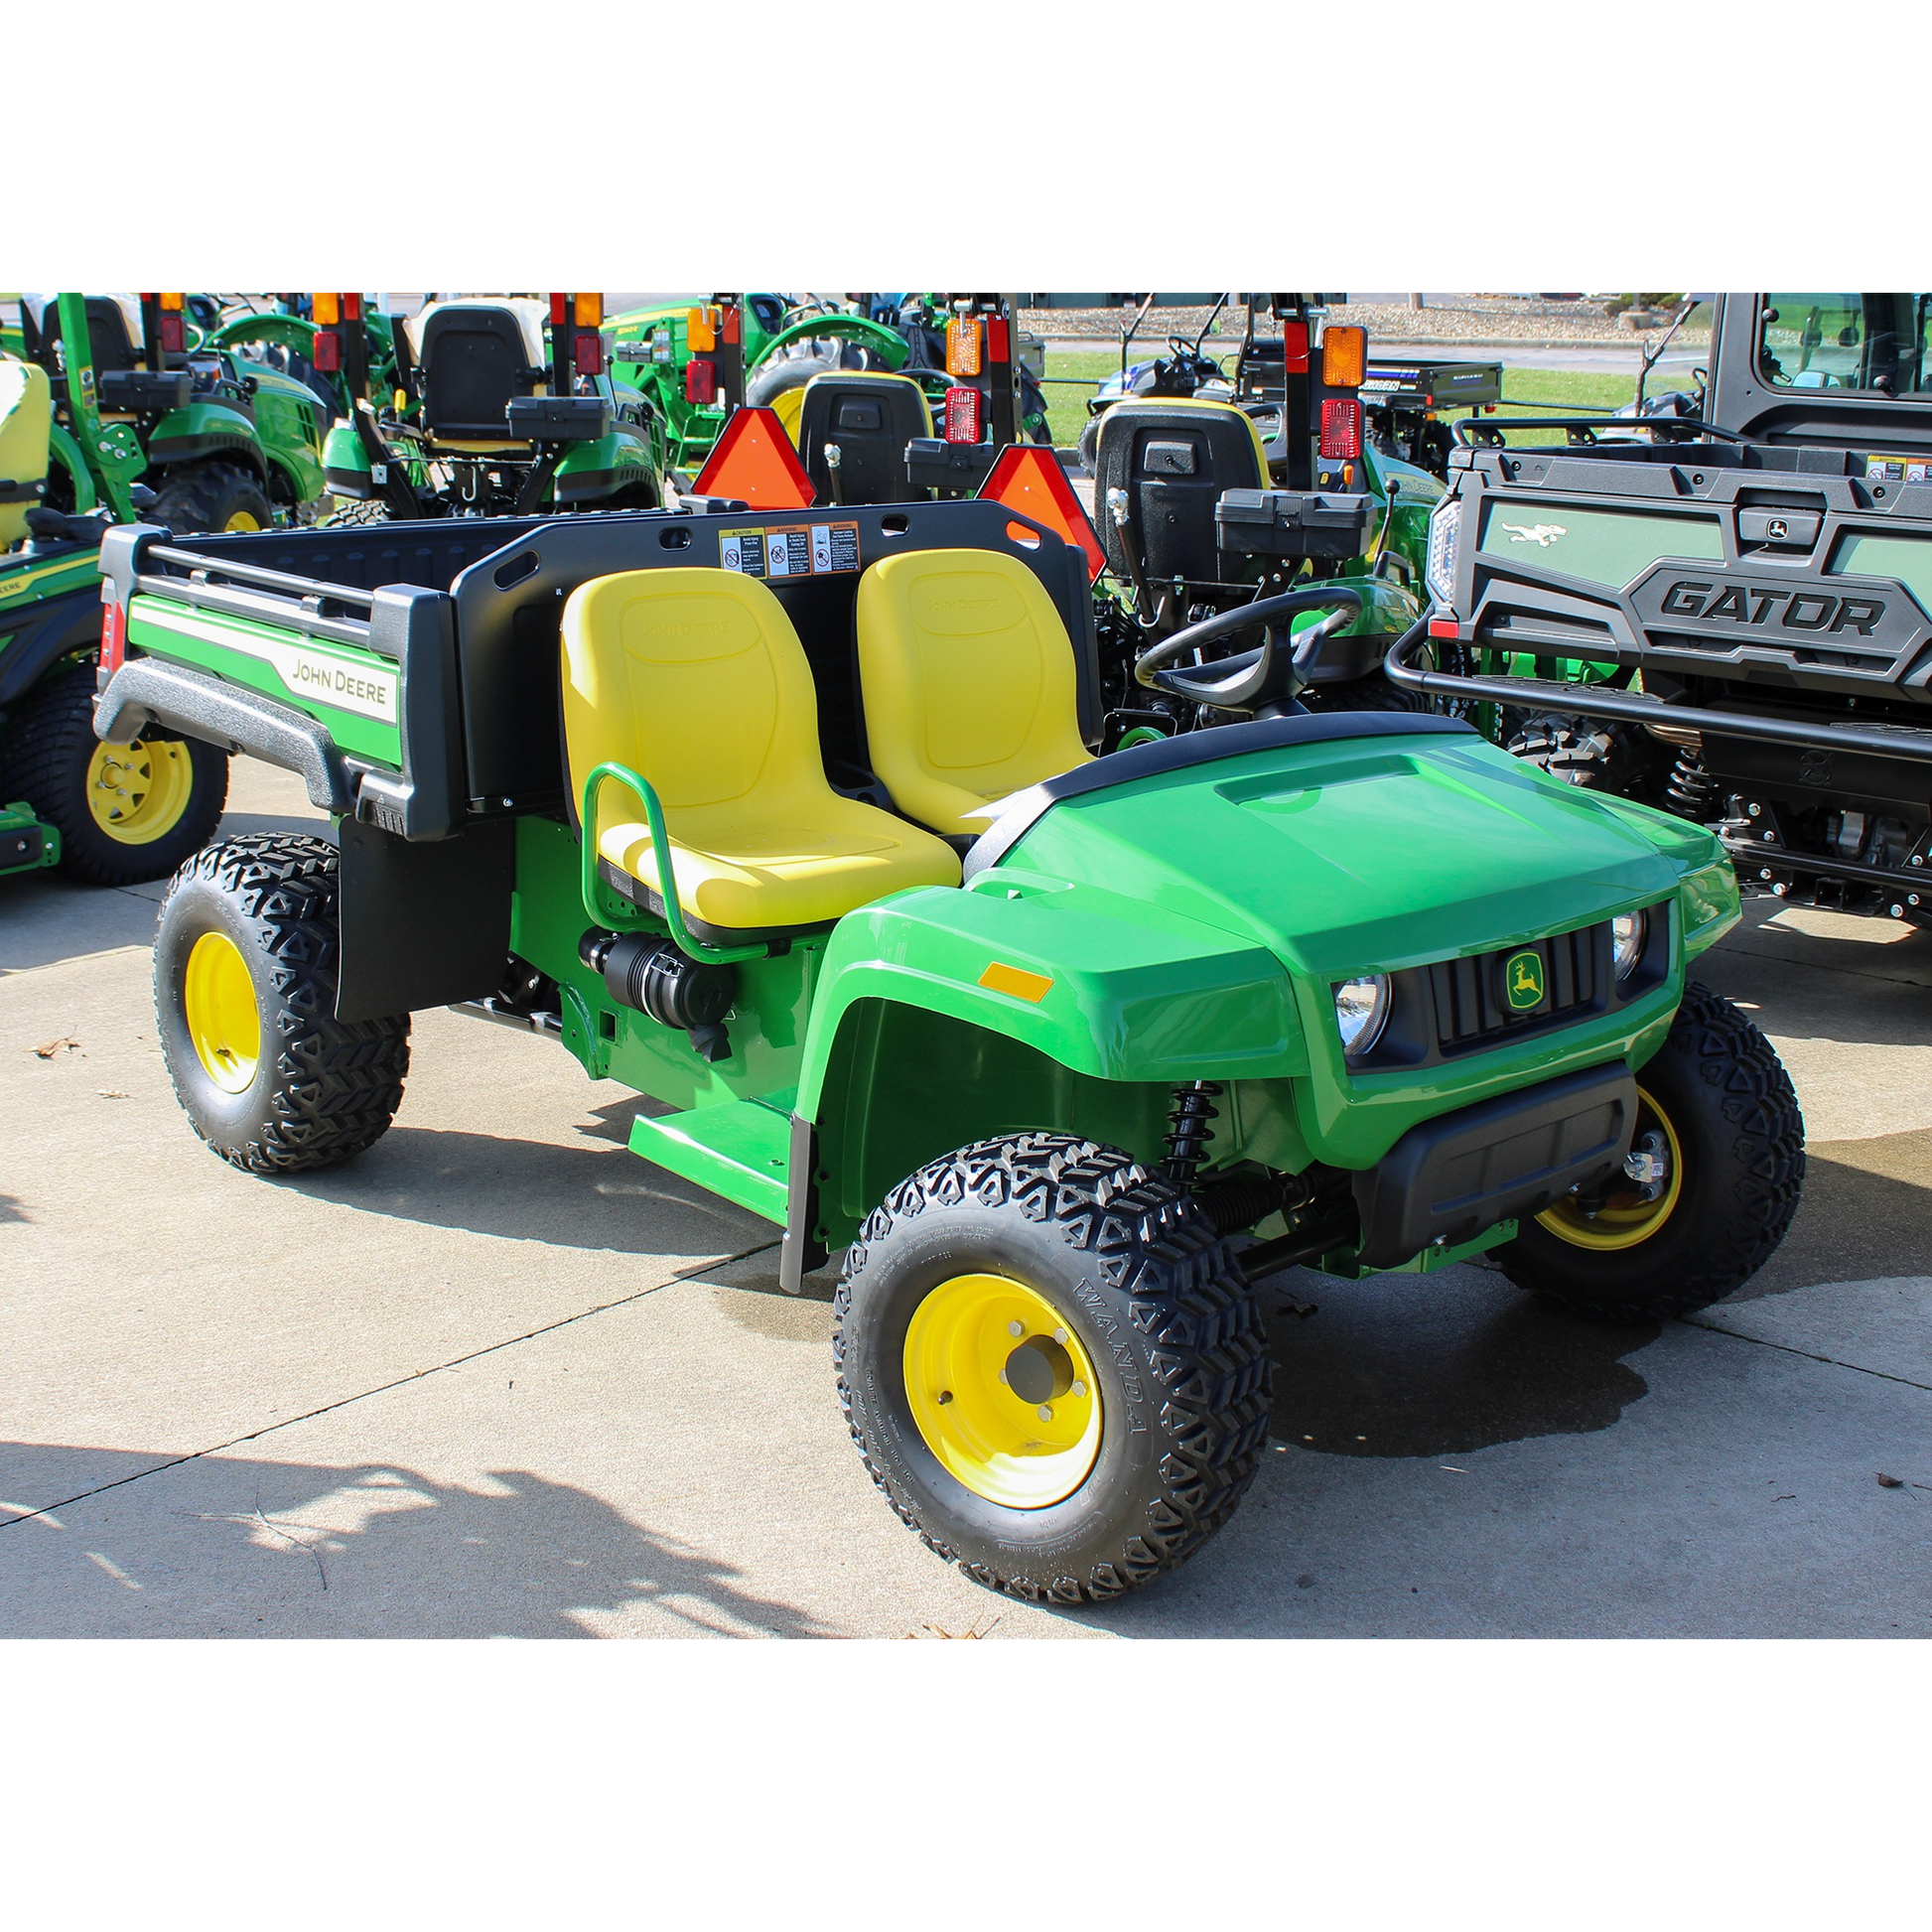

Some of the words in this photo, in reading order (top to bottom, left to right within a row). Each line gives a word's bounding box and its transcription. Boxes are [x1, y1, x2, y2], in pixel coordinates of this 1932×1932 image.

[1661, 581, 1886, 637] GATOR
[293, 659, 331, 688] JOHN
[336, 670, 386, 705] DEERE
[1073, 1277, 1148, 1435] WANDA
